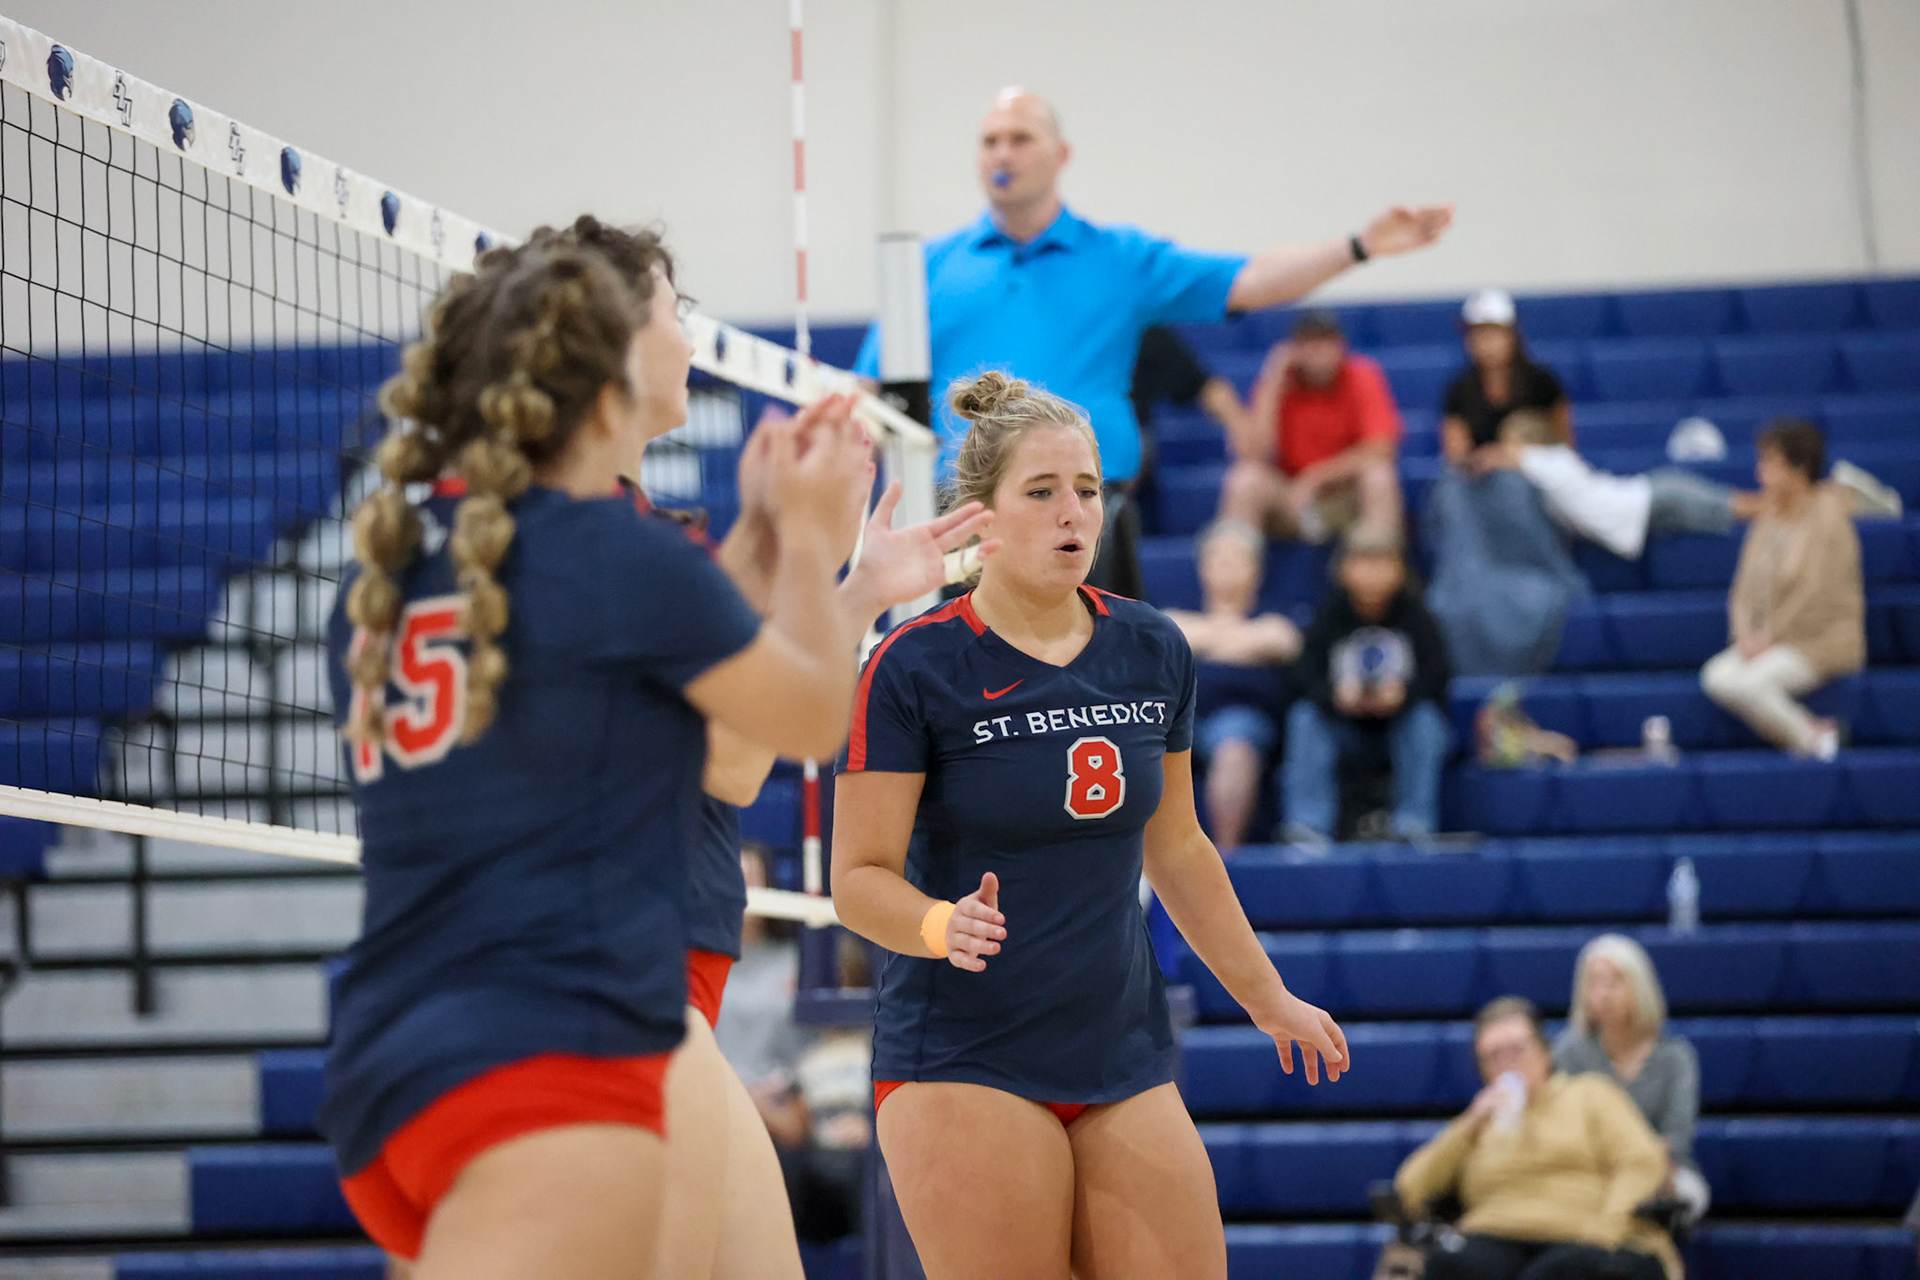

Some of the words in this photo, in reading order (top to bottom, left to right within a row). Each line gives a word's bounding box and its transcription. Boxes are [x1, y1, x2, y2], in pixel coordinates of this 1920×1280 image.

[973, 716, 1019, 744] ST.
[1025, 701, 1166, 734] BENEDICT
[1063, 736, 1126, 820] 8
